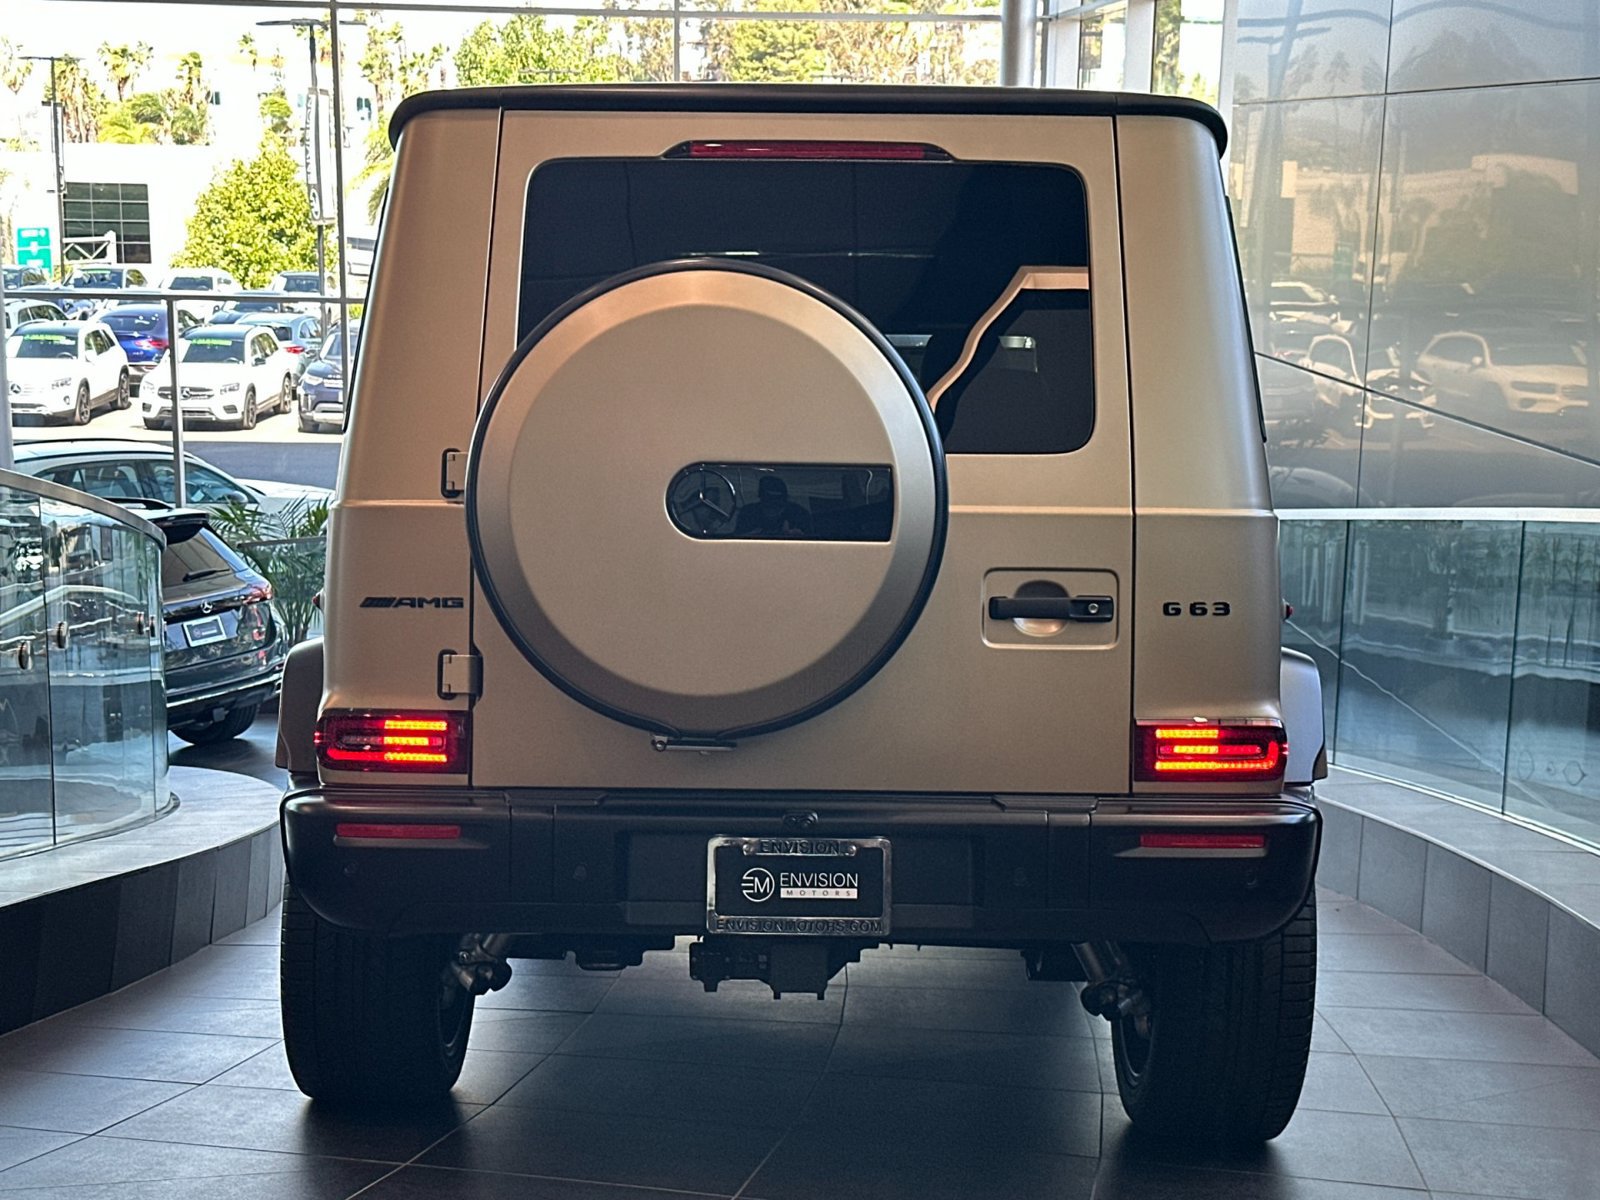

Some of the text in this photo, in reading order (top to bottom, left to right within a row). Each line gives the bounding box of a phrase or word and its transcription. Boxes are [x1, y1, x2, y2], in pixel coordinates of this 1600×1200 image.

[392, 597, 464, 608] AMG
[760, 839, 840, 854] ENVISION
[780, 873, 858, 887] ENVISION
[786, 889, 851, 897] MOTORS
[716, 919, 883, 933] ENVISIONMOTORS.COM
